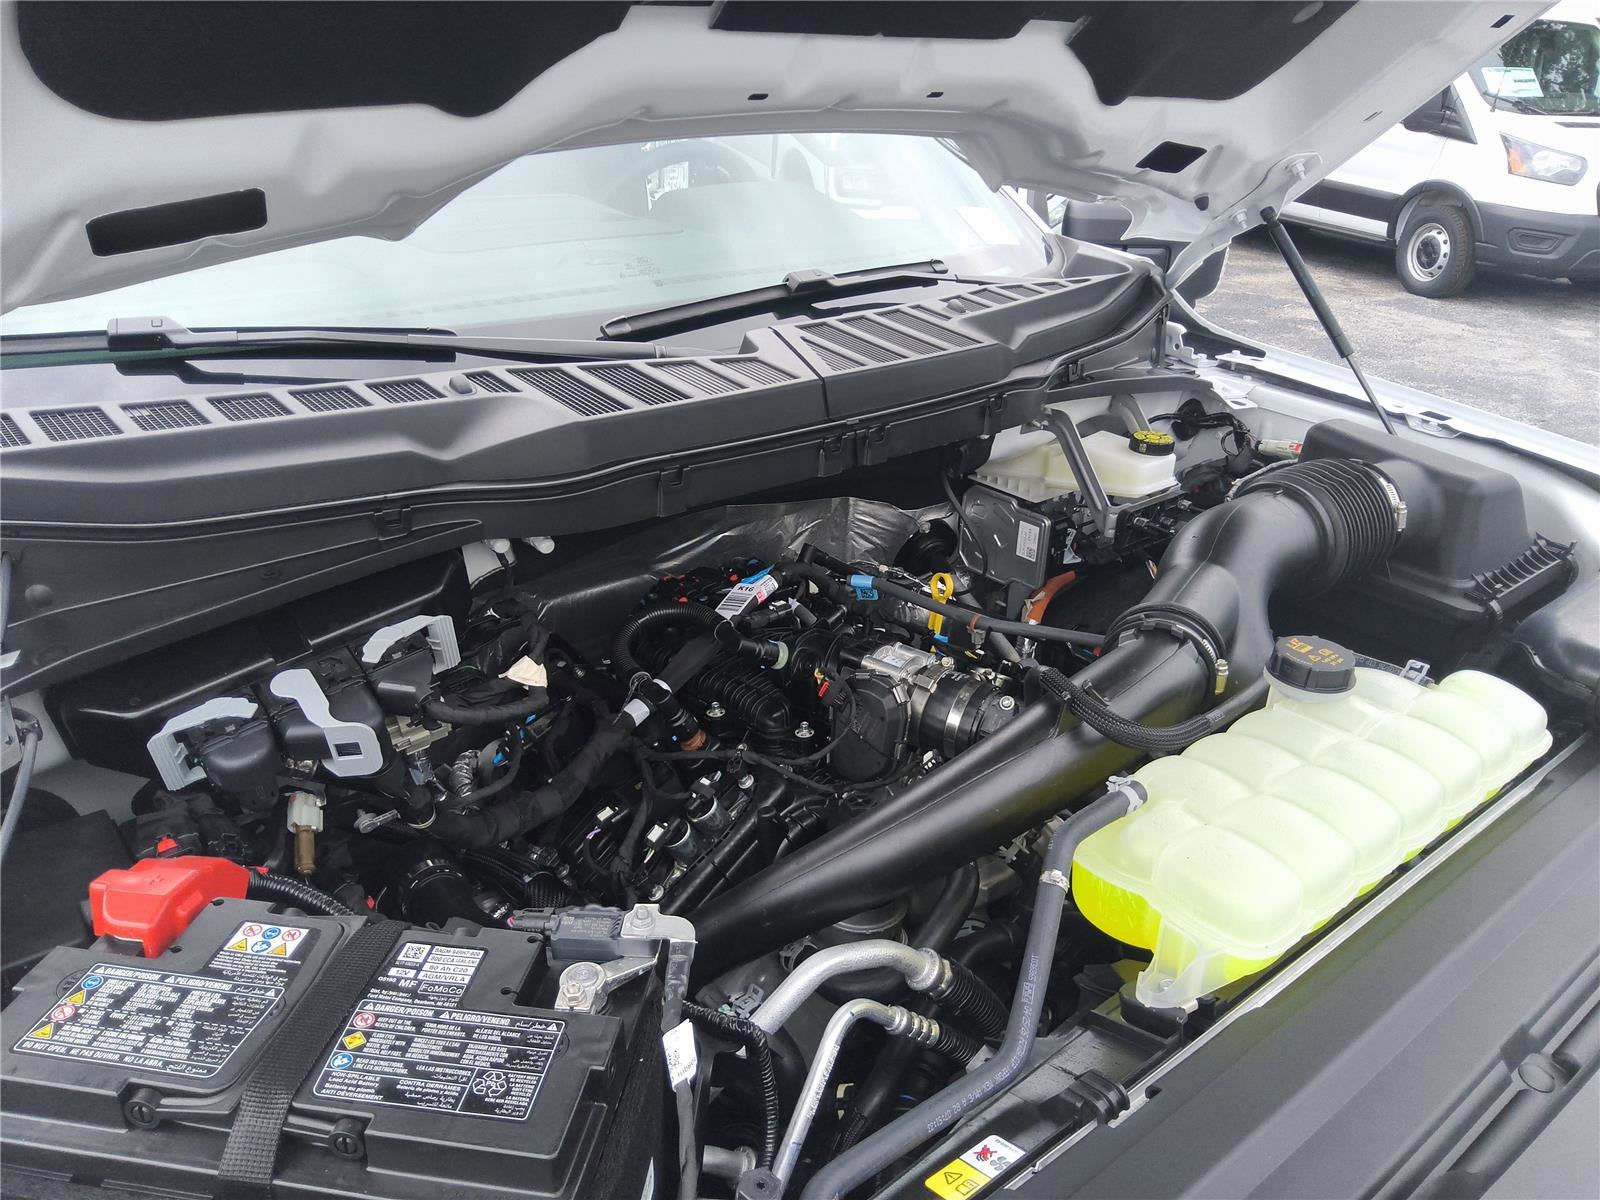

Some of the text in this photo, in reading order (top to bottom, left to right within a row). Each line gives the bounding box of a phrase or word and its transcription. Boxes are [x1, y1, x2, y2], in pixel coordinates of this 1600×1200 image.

[422, 973, 466, 982] AGM/VRLA
[399, 979, 418, 988] MF
[421, 984, 463, 994] FoMoCo
[374, 1004, 435, 1017] DANGER/POISON
[451, 1013, 511, 1025] PELIGRO/VENENO
[399, 1079, 425, 1087] CONTRA
